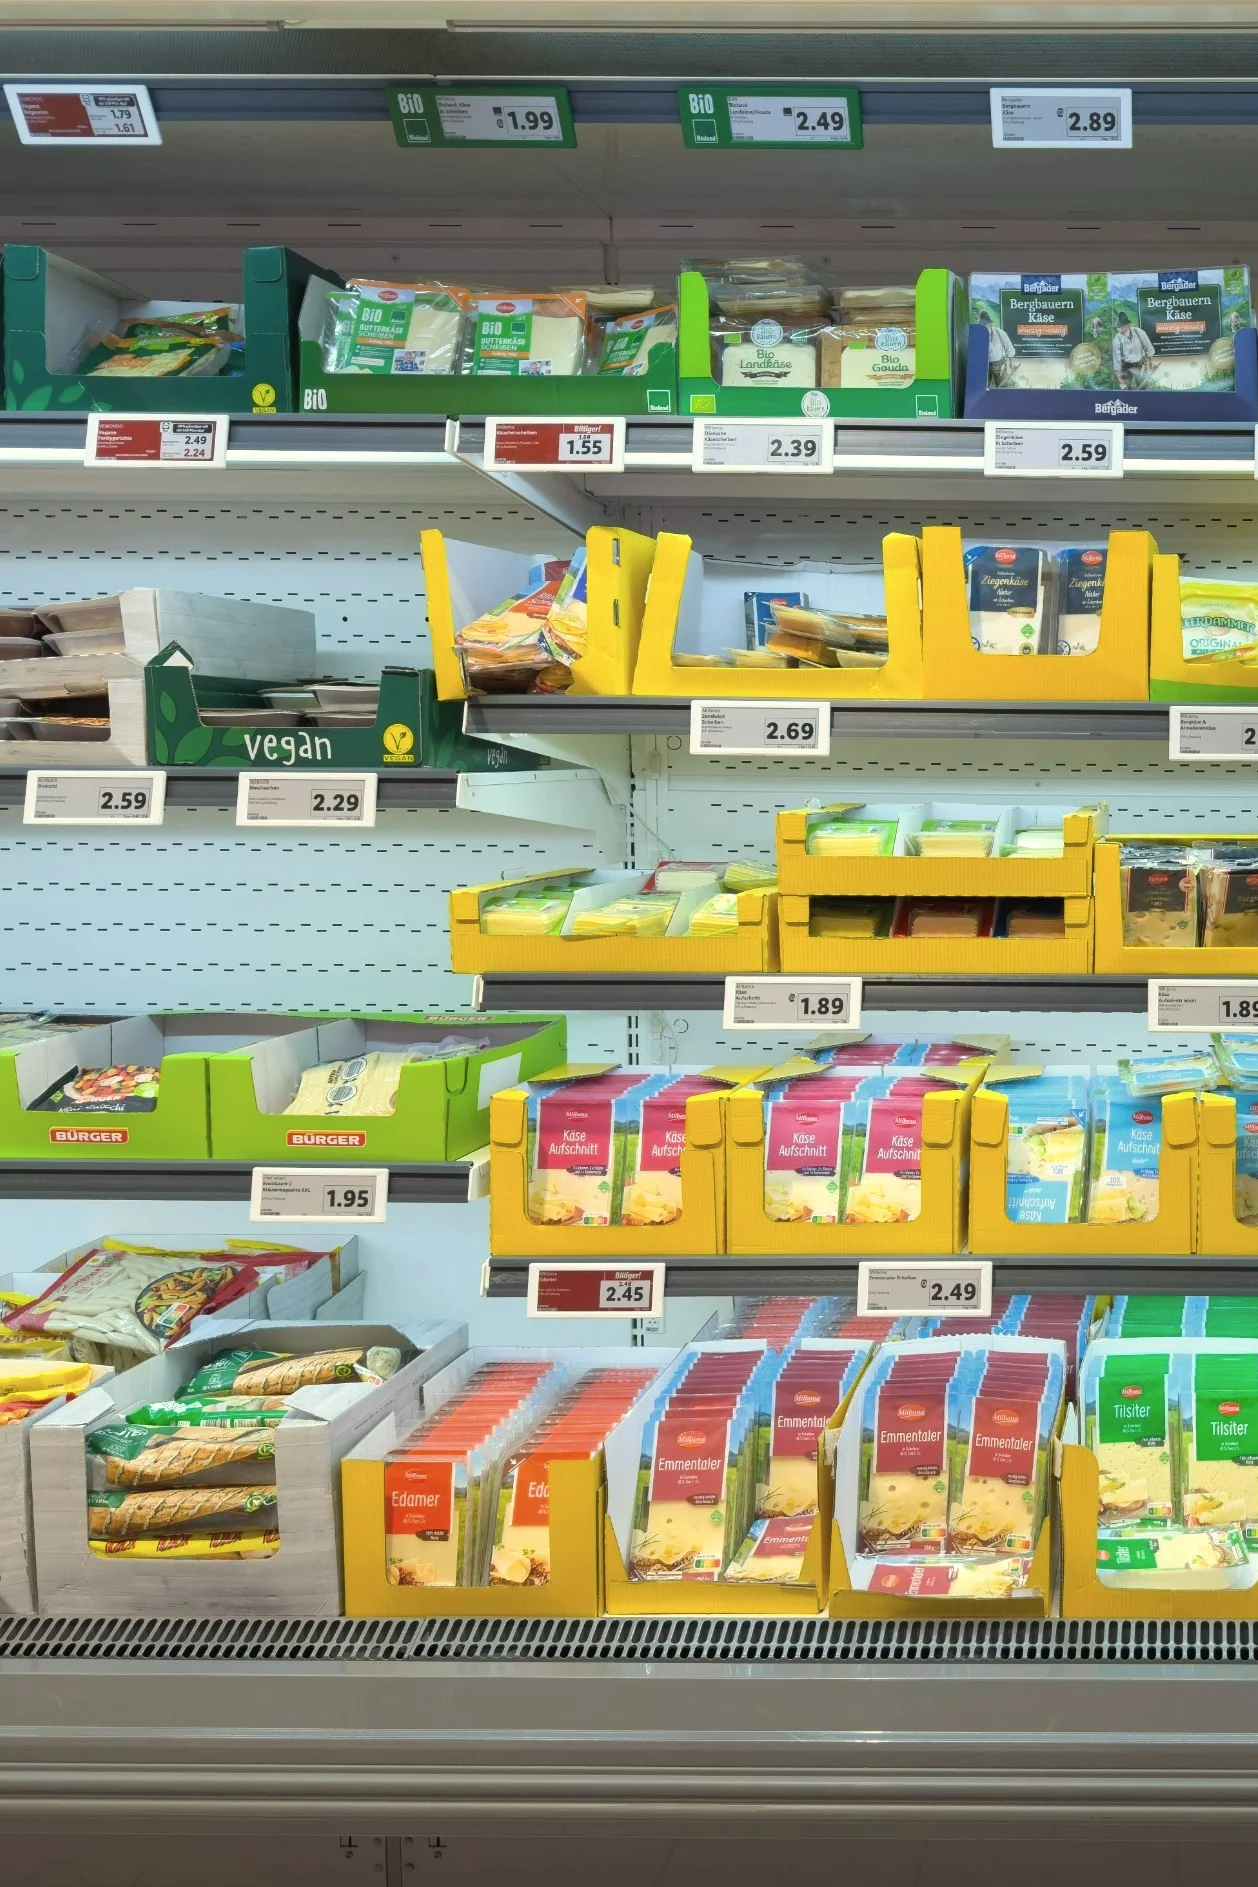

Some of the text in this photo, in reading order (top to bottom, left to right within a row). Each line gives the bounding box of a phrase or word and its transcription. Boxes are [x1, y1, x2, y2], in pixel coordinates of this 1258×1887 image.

[397, 93, 424, 114] BiO
[688, 94, 714, 114] BiO
[110, 109, 132, 120] 1.79
[507, 111, 554, 130] 1.99
[796, 112, 844, 130] 2.49
[1068, 111, 1116, 132] 2.89
[115, 123, 136, 133] 1.61
[1023, 283, 1059, 295] Bergader
[1161, 281, 1197, 293] Bergader
[1010, 299, 1075, 311] Bergbauern
[1147, 297, 1212, 309] Bergbauern
[362, 308, 382, 323] BiO
[1027, 312, 1055, 323] Käse
[1166, 310, 1192, 321] Käse
[359, 323, 404, 334] BUTTERKÄSE
[757, 349, 774, 359] Bio
[881, 355, 900, 364] Bio
[739, 358, 793, 370] Landkäse
[872, 363, 909, 372] Gouda
[304, 389, 327, 410] BiO
[1094, 402, 1138, 415] Bergader
[573, 424, 602, 433] Billiger!
[184, 435, 207, 445] 2.49
[566, 439, 602, 455] 1.55
[183, 448, 206, 458] 2.24
[770, 439, 817, 457] 2.39
[1061, 443, 1107, 461] 2.59
[981, 577, 1028, 586] Ziegenkäse
[766, 722, 814, 740] 2.69
[244, 732, 331, 764] vegan
[101, 792, 146, 809] 2.59
[313, 794, 359, 811] 2.29
[801, 997, 843, 1014] 1.89
[55, 1129, 123, 1142] BÜRGER
[292, 1132, 360, 1146] BÜRGER
[564, 1129, 586, 1143] Käse
[793, 1132, 815, 1144] Käse
[1131, 1130, 1152, 1141] Käse
[549, 1143, 598, 1156] Aufschnitt
[779, 1143, 826, 1157] Aufschnitt
[326, 1190, 368, 1208] 1.95
[615, 1271, 641, 1280] Billiger!
[606, 1287, 644, 1302] 2.45
[931, 1283, 976, 1301] 2.49
[897, 1407, 925, 1418] Milbona
[1114, 1404, 1150, 1418] Tilsiter
[1211, 1421, 1248, 1436] Tilsiter
[881, 1430, 941, 1444] Emmentaler
[976, 1434, 1033, 1450] Emmentaler
[658, 1456, 720, 1473] Emmentaler
[391, 1492, 439, 1507] Edamer
